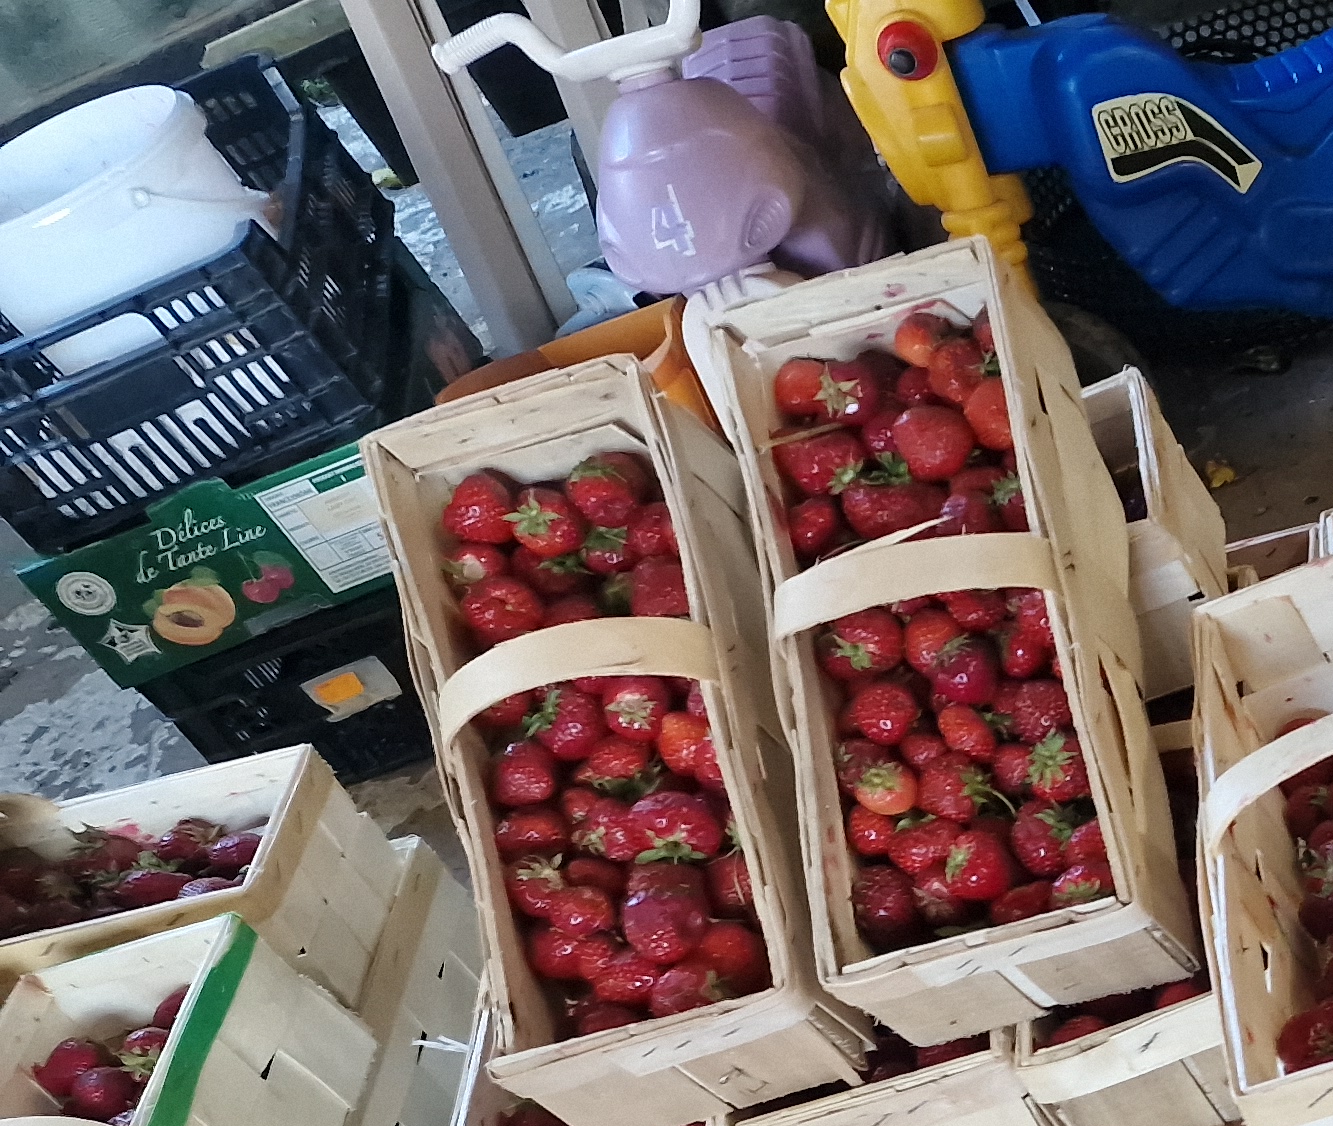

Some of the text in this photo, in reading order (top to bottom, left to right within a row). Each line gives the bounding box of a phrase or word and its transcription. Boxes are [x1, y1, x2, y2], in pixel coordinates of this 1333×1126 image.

[1097, 97, 1189, 154] CROSS
[137, 525, 267, 584] de Tante Line
[149, 508, 227, 550] Délices
